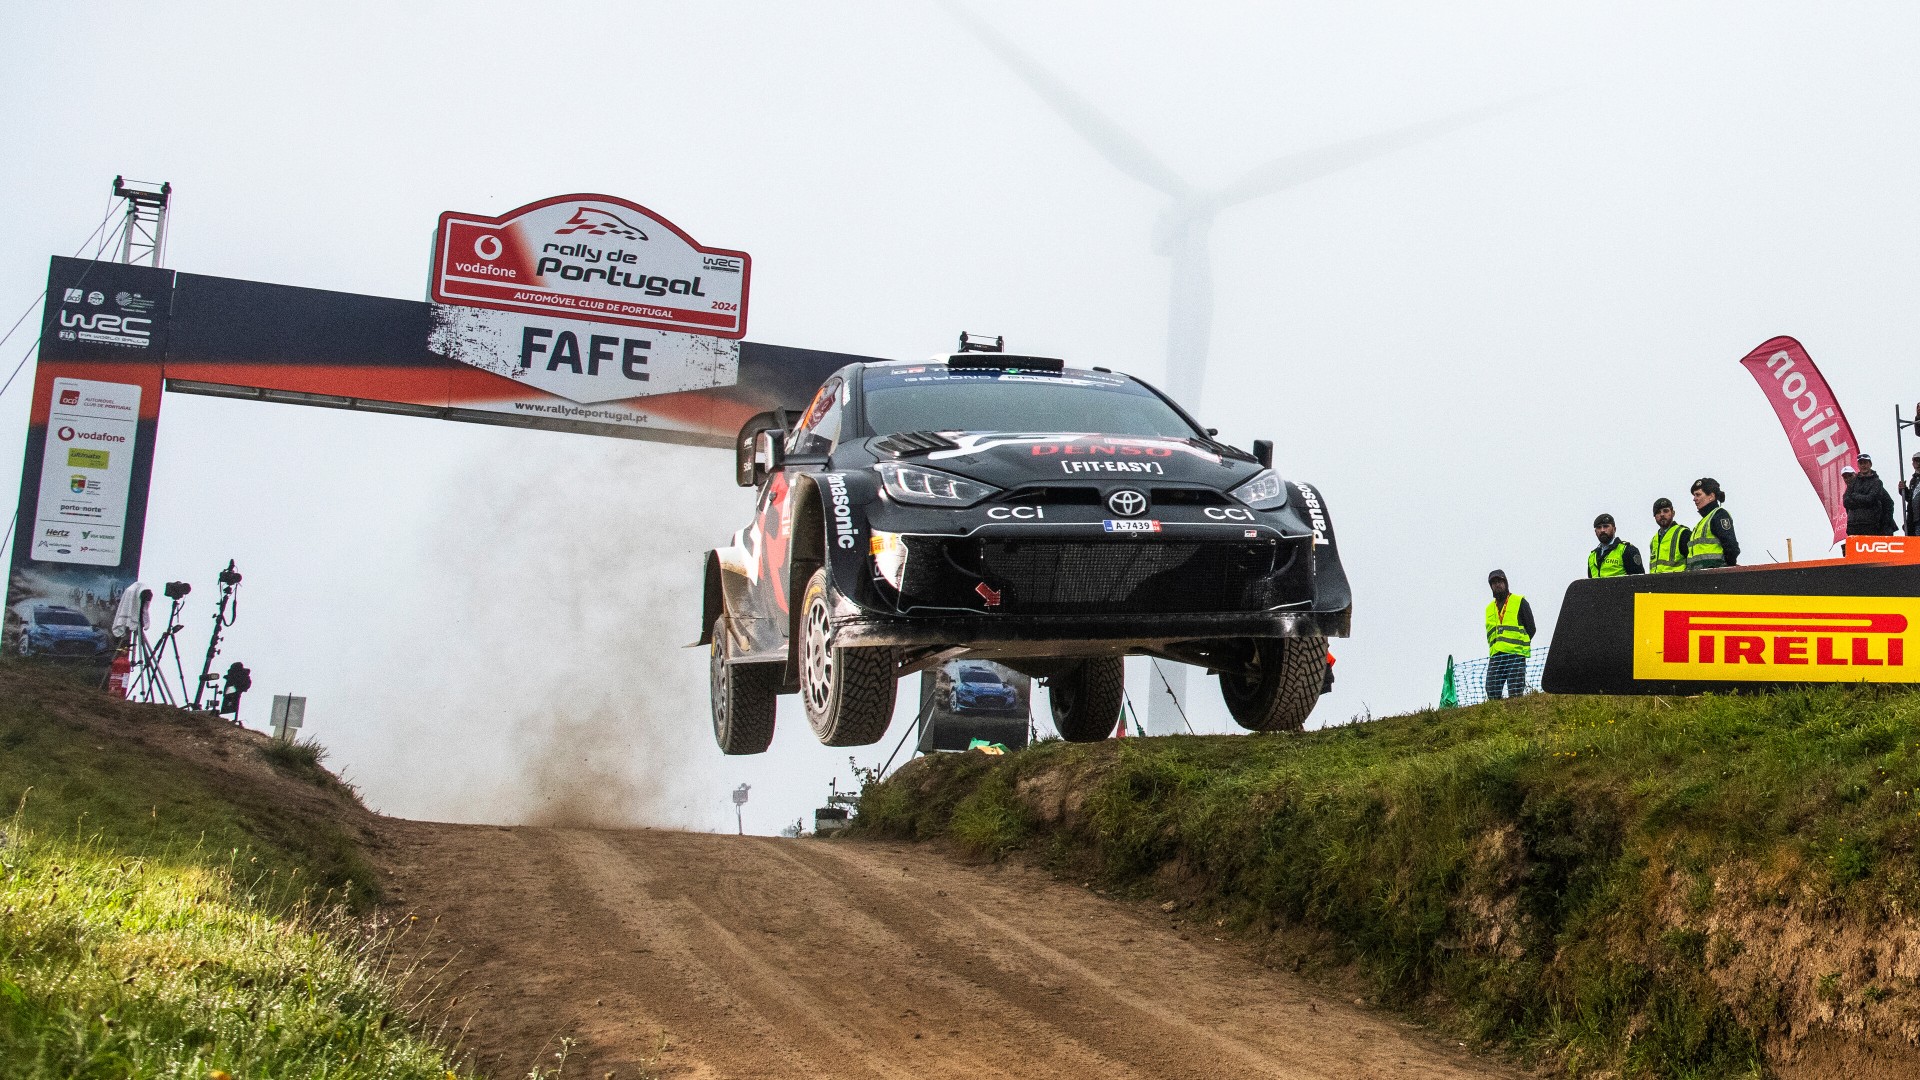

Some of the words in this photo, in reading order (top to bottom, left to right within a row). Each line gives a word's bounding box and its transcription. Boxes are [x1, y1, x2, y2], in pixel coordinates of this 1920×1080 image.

[542, 243, 602, 262] rally
[606, 249, 638, 265] de
[703, 256, 740, 268] WRC
[455, 261, 517, 278] vodafone
[536, 256, 706, 297] Portugal
[514, 291, 577, 306] AUTOMÓVEL
[578, 300, 605, 310] CLUB
[606, 303, 619, 311] DE
[621, 304, 673, 318] PORTUGAL
[711, 300, 737, 311] 2024
[60, 309, 152, 336] WRC
[60, 331, 76, 340] FIA
[520, 326, 652, 382] FAFE
[514, 401, 648, 424] www.rallydeportugal.pt
[77, 431, 126, 443] vodafone
[1030, 444, 1173, 457] DENSO
[987, 505, 1044, 520] CCi
[1203, 507, 1256, 521] CCi
[45, 528, 70, 537] Hertz
[1116, 521, 1150, 530] A-7439
[1855, 541, 1905, 553] WRC
[1663, 610, 1908, 666] PIRELLI
